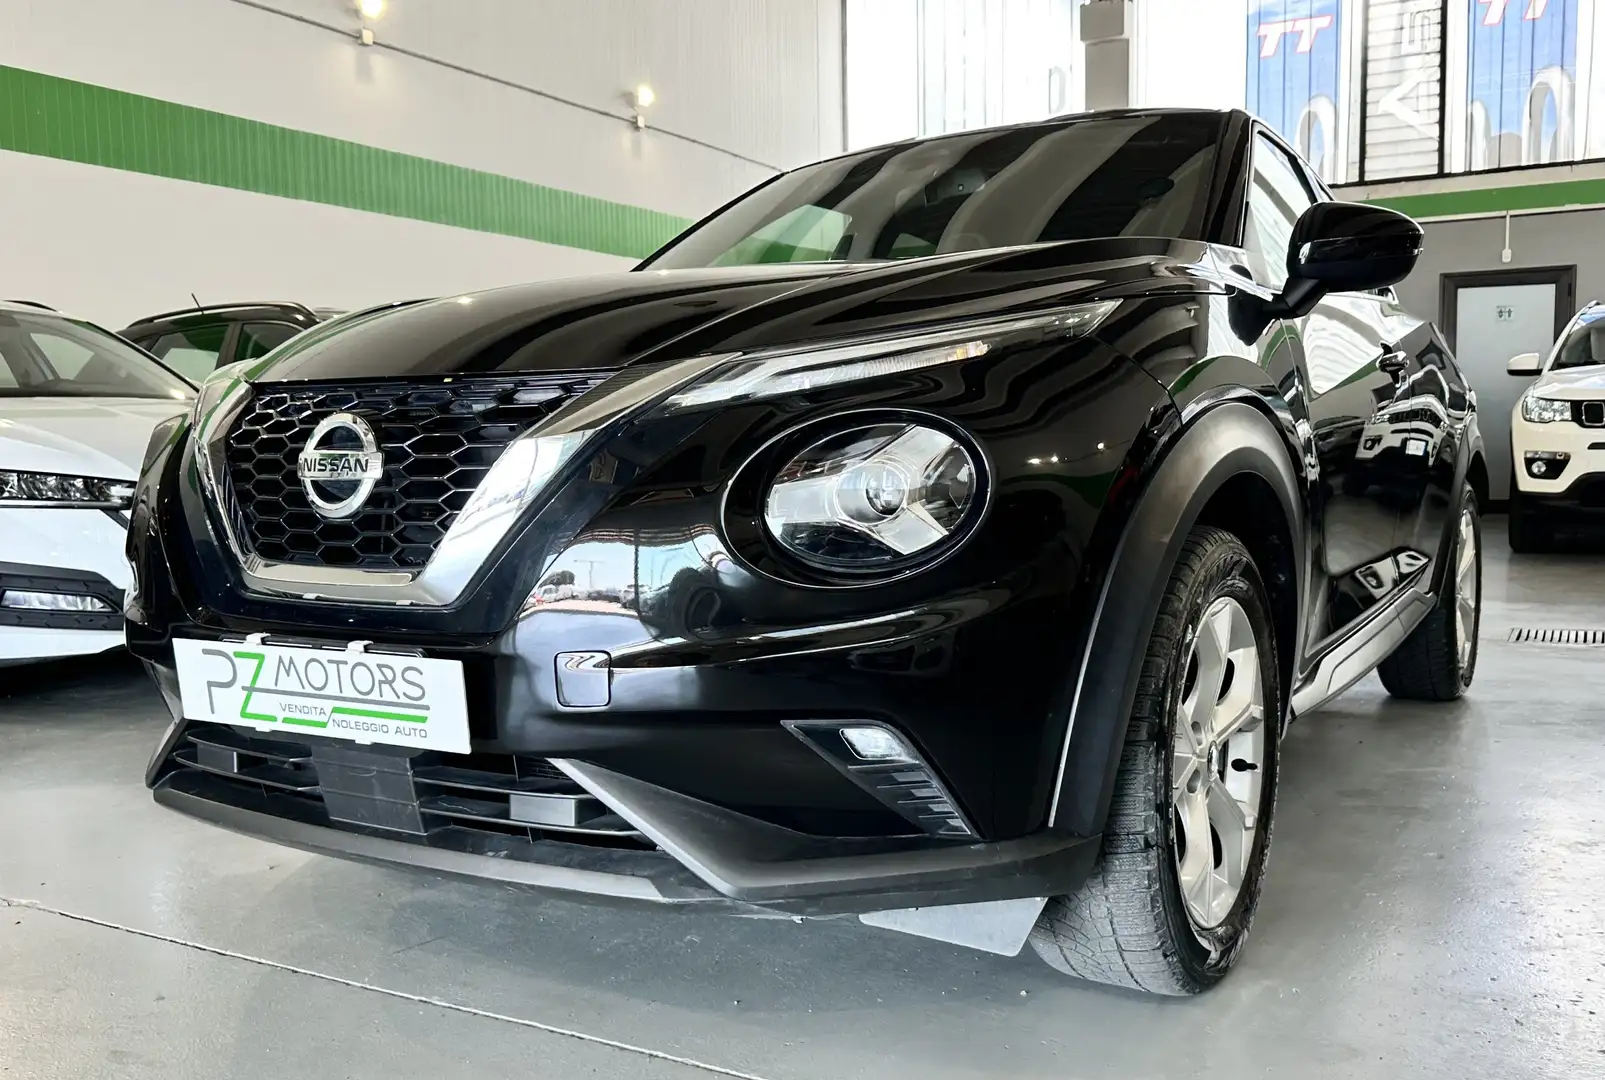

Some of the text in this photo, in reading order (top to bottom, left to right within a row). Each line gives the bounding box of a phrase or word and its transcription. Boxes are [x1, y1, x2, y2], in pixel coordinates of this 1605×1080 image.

[1257, 15, 1332, 58] TT
[302, 457, 369, 473] NISSAN
[201, 648, 426, 722] PZ MOTORS
[279, 702, 327, 717] VENDITA
[332, 718, 428, 739] NOLEGGIO AUTO
